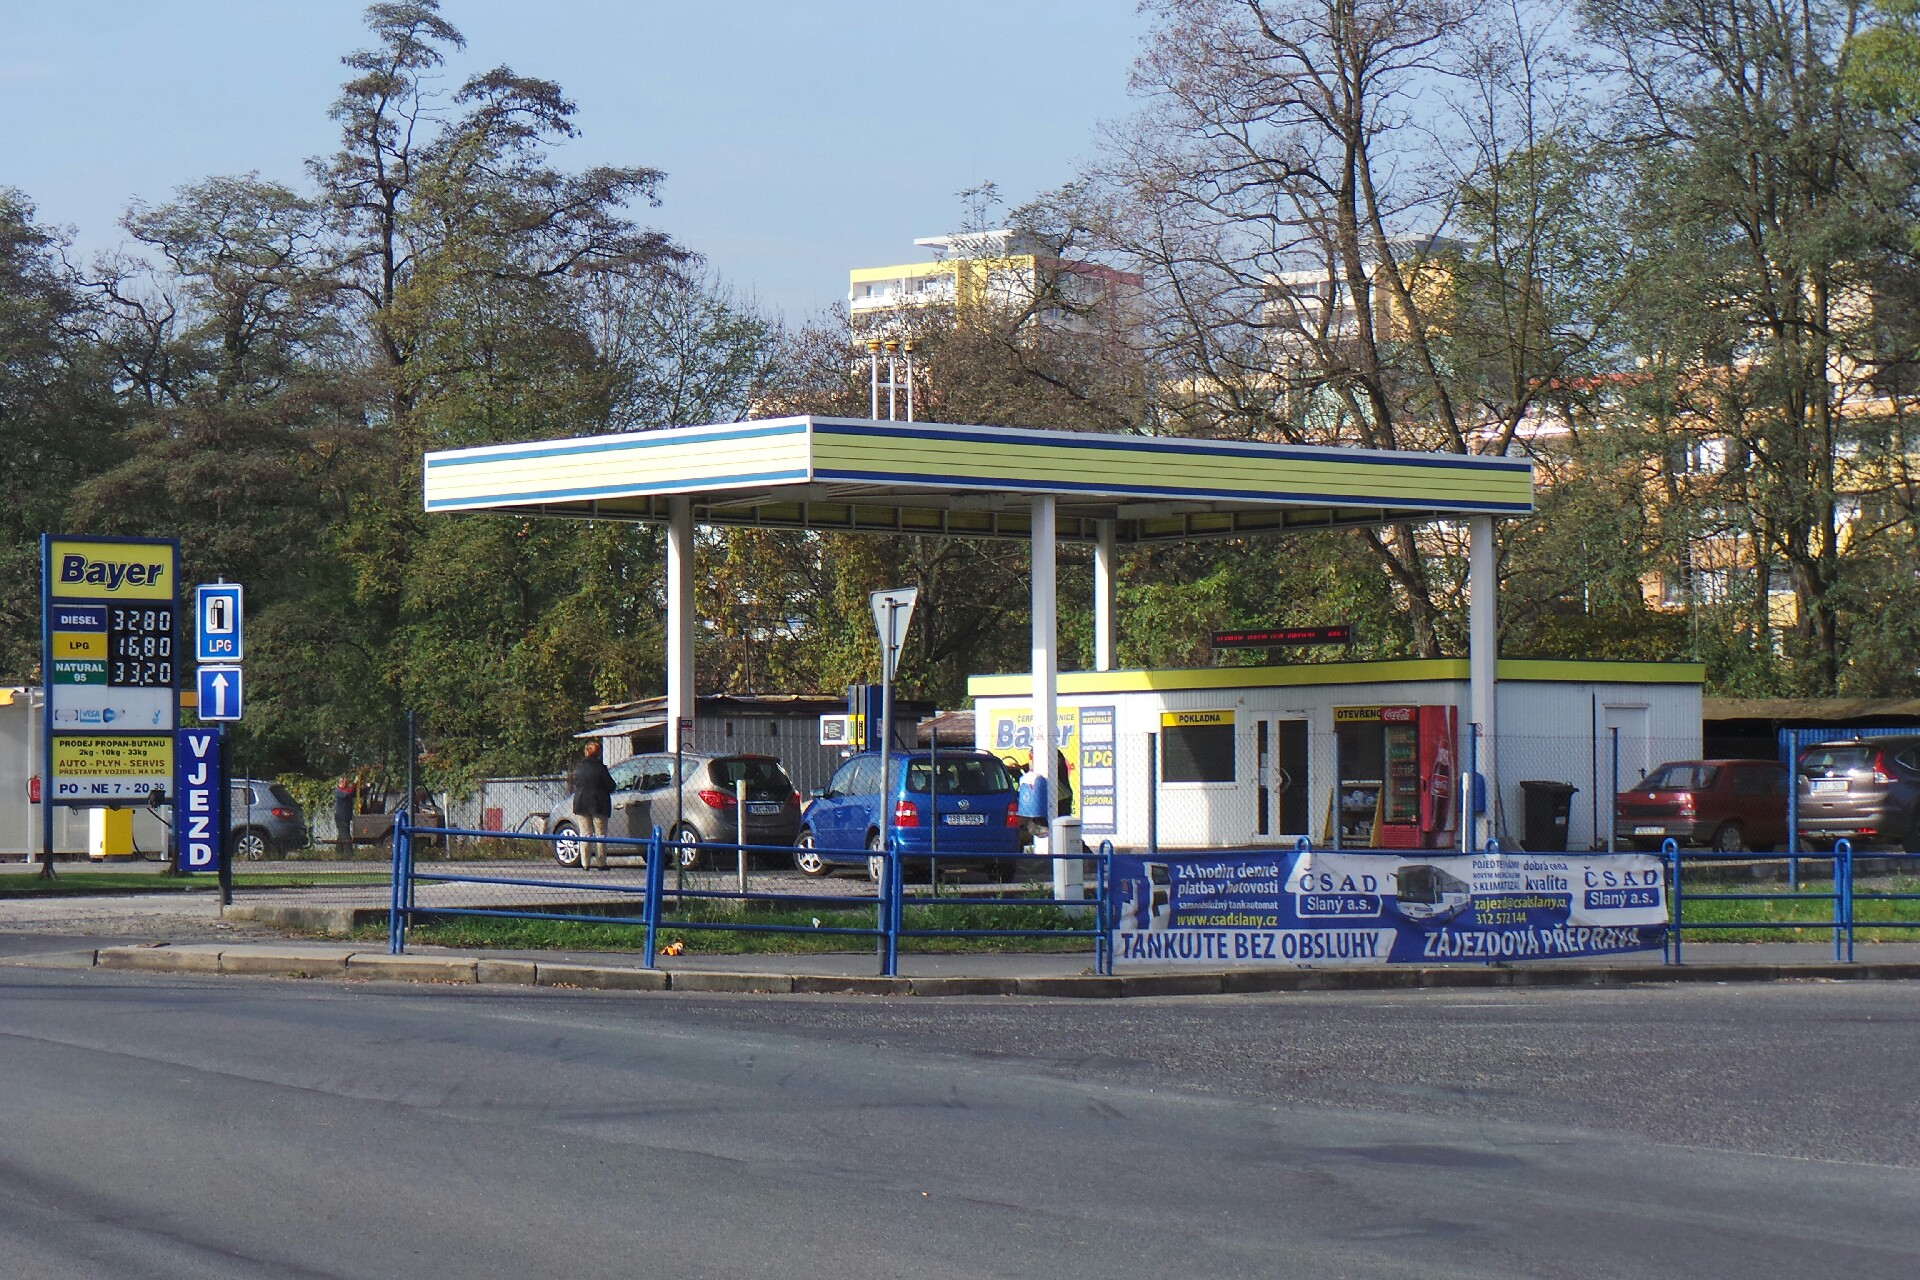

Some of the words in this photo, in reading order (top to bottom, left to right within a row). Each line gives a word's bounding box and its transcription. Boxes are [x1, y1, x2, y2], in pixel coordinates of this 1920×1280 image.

[60, 553, 163, 591] Bayer
[61, 615, 98, 625] DIESEL
[69, 642, 90, 650] LPG
[209, 640, 232, 653] LPG
[55, 663, 105, 672] NATURAL
[73, 673, 87, 682] 95
[83, 708, 100, 718] VISA
[1179, 714, 1221, 723] POKLADNA
[60, 740, 92, 748] PRODEJ
[95, 740, 165, 748] PROPAN-BUTANU
[79, 749, 94, 757] 2kg
[101, 749, 121, 757] 10kg
[127, 749, 147, 757] 33kg
[59, 760, 87, 768] AUTO
[95, 760, 121, 768] PLYN
[129, 760, 165, 768] SERVIS
[1083, 751, 1113, 768] LPG
[59, 768, 102, 776] PŘESTAVBY
[59, 783, 79, 794] PO
[91, 784, 109, 794] NE
[114, 784, 121, 794] 7
[134, 783, 149, 793] 20
[1176, 864, 1195, 878] 24
[1195, 863, 1234, 878] hodin
[1523, 860, 1548, 870] dobrá
[1549, 862, 1568, 870] cena
[1299, 867, 1378, 892] ČSAD
[1584, 865, 1658, 888] ČSAD
[1473, 882, 1478, 891] S
[1525, 875, 1568, 890] kvalita
[1177, 881, 1215, 898] platba
[1217, 884, 1225, 894] v
[1226, 880, 1278, 894] hotovosti
[1307, 896, 1343, 913] Slaný
[1347, 899, 1371, 910] a.s.
[1590, 890, 1627, 908] Slaný
[1630, 892, 1653, 904] a.s.
[1229, 900, 1278, 910] tankautomat
[1177, 912, 1278, 929] www.csadslany.cz
[1476, 913, 1493, 924] 312
[1496, 913, 1511, 924] 572
[1512, 912, 1526, 923] 144
[1121, 932, 1228, 958] TANKUJTE
[1234, 932, 1275, 958] BEZ
[1282, 932, 1379, 958] OBSLUHY
[1423, 924, 1539, 957] ZÁJEZDOVÁ
[1540, 922, 1640, 954] PŘEPRAVA
